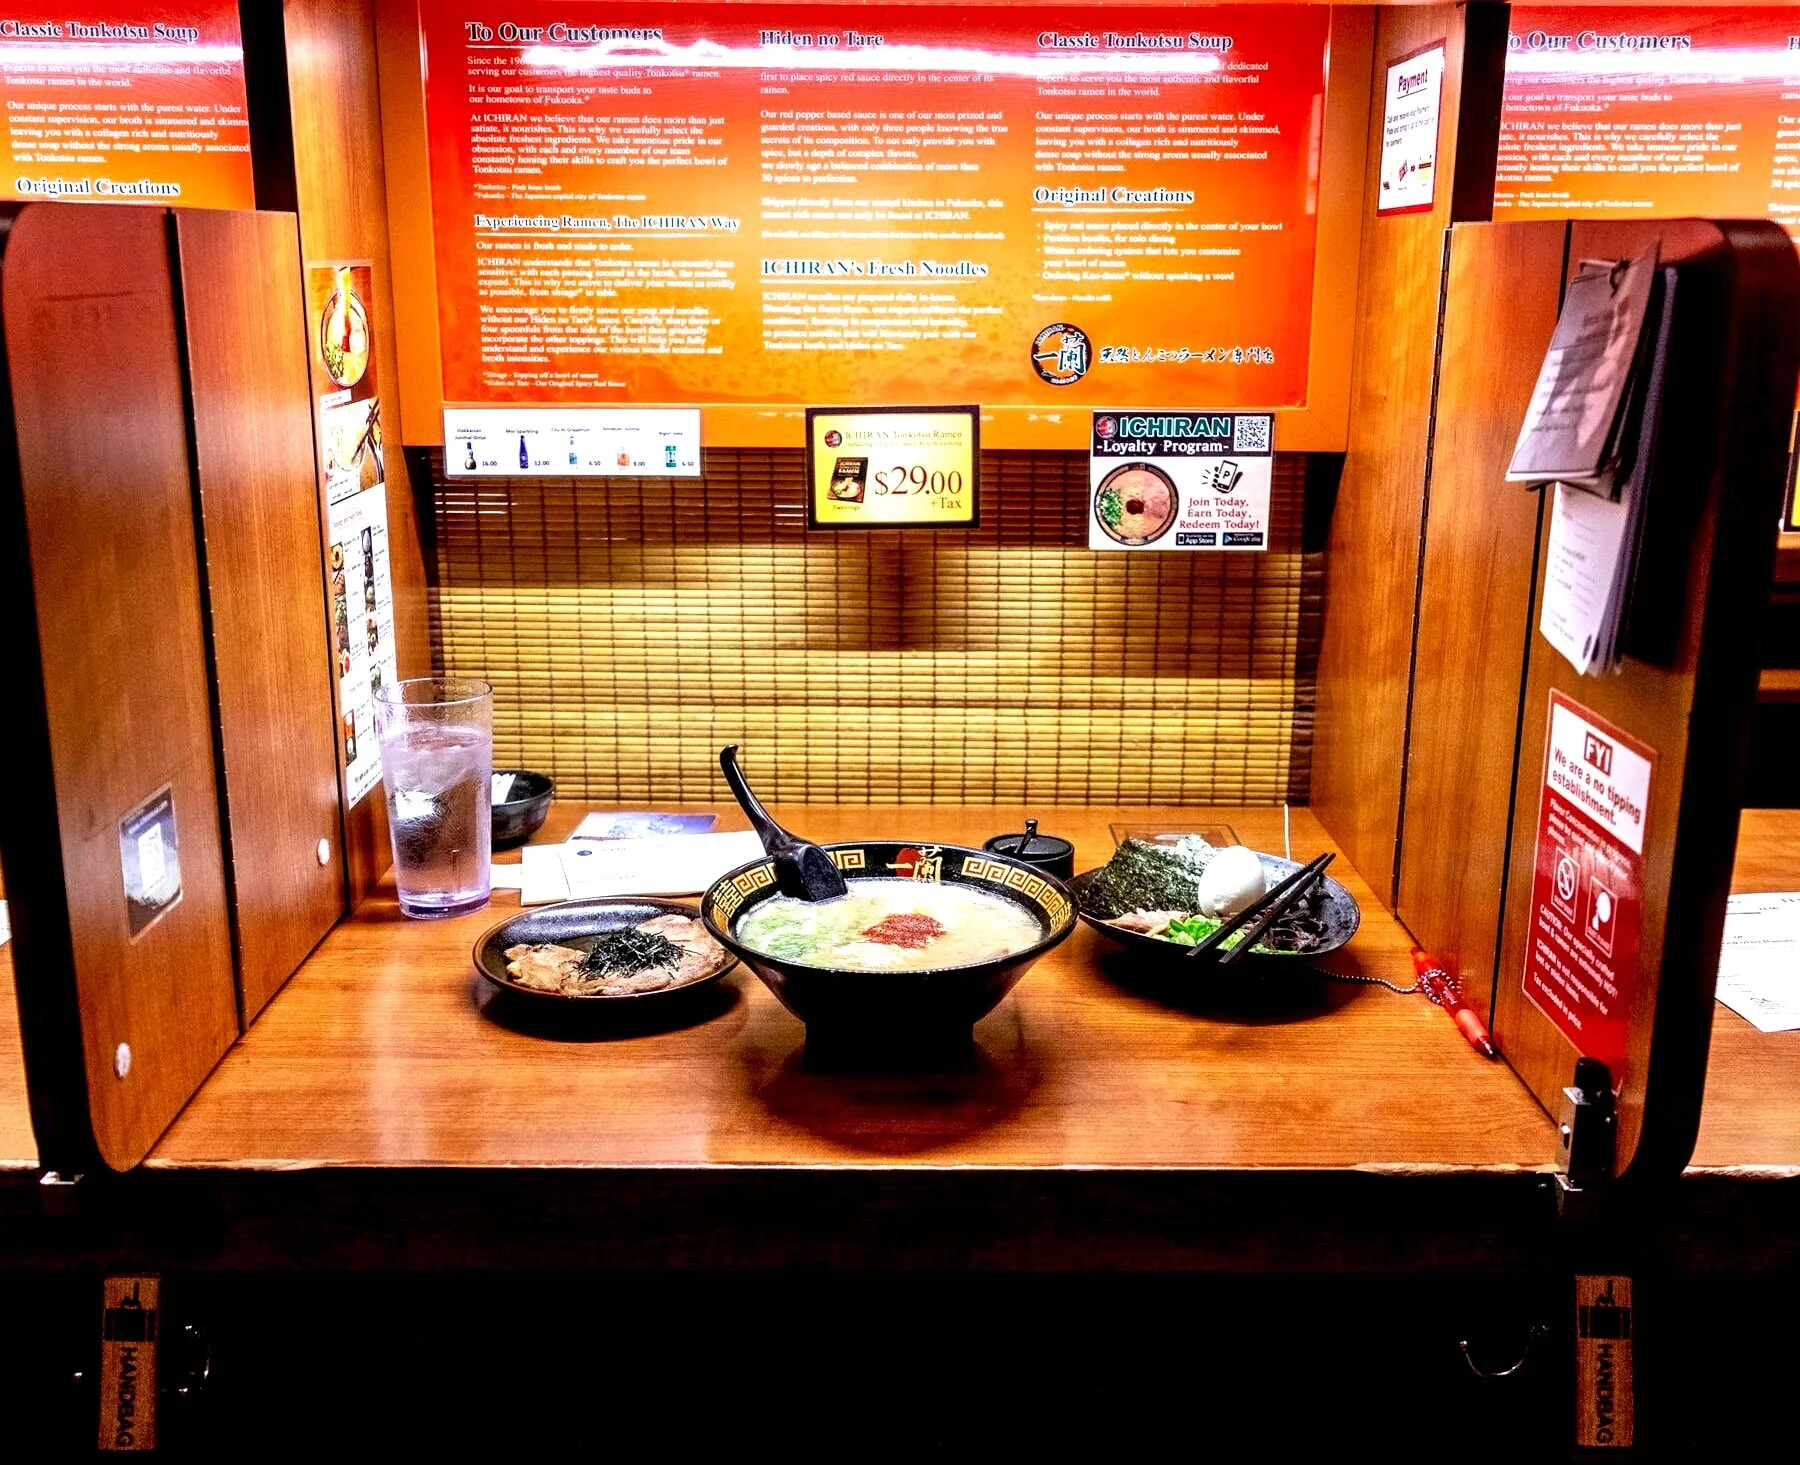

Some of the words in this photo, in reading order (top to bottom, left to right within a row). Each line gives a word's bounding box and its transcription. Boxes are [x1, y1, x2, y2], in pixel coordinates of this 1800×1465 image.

[0, 20, 63, 37] Classic
[66, 21, 148, 39] Tonkotsu
[153, 24, 199, 42] Soup
[465, 22, 493, 42] To
[498, 22, 542, 42] Our
[548, 22, 662, 43] Customers
[760, 30, 811, 46] Hiden
[818, 35, 838, 46] no
[844, 31, 884, 47] Tare
[1037, 32, 1098, 48] Classic
[1103, 33, 1183, 48] Tonkotsu
[1189, 35, 1233, 51] Soup
[1527, 30, 1572, 51] Our
[1576, 30, 1691, 51] Customers
[1227, 61, 1268, 71] dedicated
[468, 83, 475, 93] It
[477, 83, 485, 93] is
[486, 85, 502, 93] our
[504, 84, 523, 96] goal
[524, 84, 534, 94] to
[535, 85, 574, 97] transport
[576, 86, 596, 97] your
[598, 85, 618, 94] taste
[620, 85, 640, 95] buds
[642, 85, 652, 95] to
[1398, 69, 1428, 94] Payment
[485, 95, 532, 104] hometown
[533, 95, 543, 104] of
[1038, 86, 1076, 96] Tonkotsu
[1078, 88, 1105, 96] ramen
[1107, 86, 1116, 97] in
[1117, 86, 1131, 97] the
[1133, 87, 1158, 97] world.
[6, 100, 25, 110] Our
[26, 101, 57, 113] unique
[58, 103, 92, 114] process
[93, 102, 118, 112] starts
[119, 102, 139, 112] with
[140, 102, 154, 112] the
[156, 103, 183, 115] purest
[185, 103, 209, 113] water.
[214, 103, 241, 113] Under
[761, 109, 777, 119] Our
[779, 109, 793, 119] red
[795, 111, 824, 122] pepper
[826, 109, 851, 119] based
[853, 111, 876, 119] sauce
[879, 109, 886, 119] is
[888, 111, 904, 119] one
[906, 109, 915, 120] of
[917, 112, 932, 120] our
[934, 110, 955, 120] most
[957, 110, 984, 122] prized
[986, 110, 1002, 120] and
[471, 113, 481, 123] At
[483, 113, 527, 123] ICHIRAN
[530, 115, 542, 123] we
[544, 113, 575, 124] believe
[577, 114, 594, 124] that
[595, 116, 610, 124] our
[613, 116, 639, 124] ramen
[641, 114, 661, 124] does
[664, 117, 685, 125] more
[688, 115, 706, 125] than
[709, 115, 724, 127] just
[1035, 111, 1053, 121] Our
[1055, 111, 1084, 123] unique
[1085, 113, 1118, 123] process
[1119, 112, 1143, 121] starts
[1145, 111, 1164, 121] with
[1166, 111, 1179, 121] the
[1181, 112, 1208, 124] purest
[1209, 112, 1234, 121] water.
[1238, 111, 1264, 121] Under
[1036, 124, 1071, 134] constant
[1126, 126, 1141, 134] our
[1143, 124, 1166, 134] broth
[1168, 124, 1175, 134] is
[1177, 124, 1220, 134] simmered
[1221, 124, 1237, 134] and
[1036, 136, 1066, 149] leaving
[1069, 138, 1085, 149] you
[1087, 136, 1106, 146] with
[1108, 138, 1113, 146] a
[1115, 136, 1151, 149] collagen
[1153, 137, 1170, 147] rich
[1172, 137, 1188, 147] and
[1189, 137, 1237, 149] nutritiously
[15, 177, 90, 197] Original
[95, 178, 181, 197] Creations
[1032, 187, 1106, 206] Original
[1110, 188, 1193, 204] Creations
[474, 214, 560, 232] Experiencing
[613, 216, 639, 228] The
[641, 216, 708, 230] ICHIRAN
[710, 217, 740, 233] Way
[761, 259, 864, 276] ICHIRAN's
[868, 260, 916, 276] Fresh
[919, 260, 988, 277] Noodles
[1033, 332, 1086, 375] 一蘭
[933, 430, 962, 439] Ramen
[1120, 416, 1231, 438] ICHIRAN
[874, 465, 962, 496] $29.00
[930, 497, 962, 509] +Tax
[1188, 498, 1210, 508] Join
[1187, 509, 1212, 517] Earn
[1179, 520, 1221, 529] Redeem
[1224, 520, 1259, 531] Today!
[1584, 735, 1611, 773] FYI
[1555, 747, 1567, 767] We
[1569, 761, 1583, 778] are
[1585, 772, 1591, 784] a
[1593, 777, 1604, 794] no
[1607, 784, 1641, 825] tipping
[1552, 769, 1617, 826] establishment.
[885, 845, 943, 884] 一蘭
[115, 1346, 138, 1448] HANDBAG
[1595, 1343, 1614, 1445] HANDBAG
